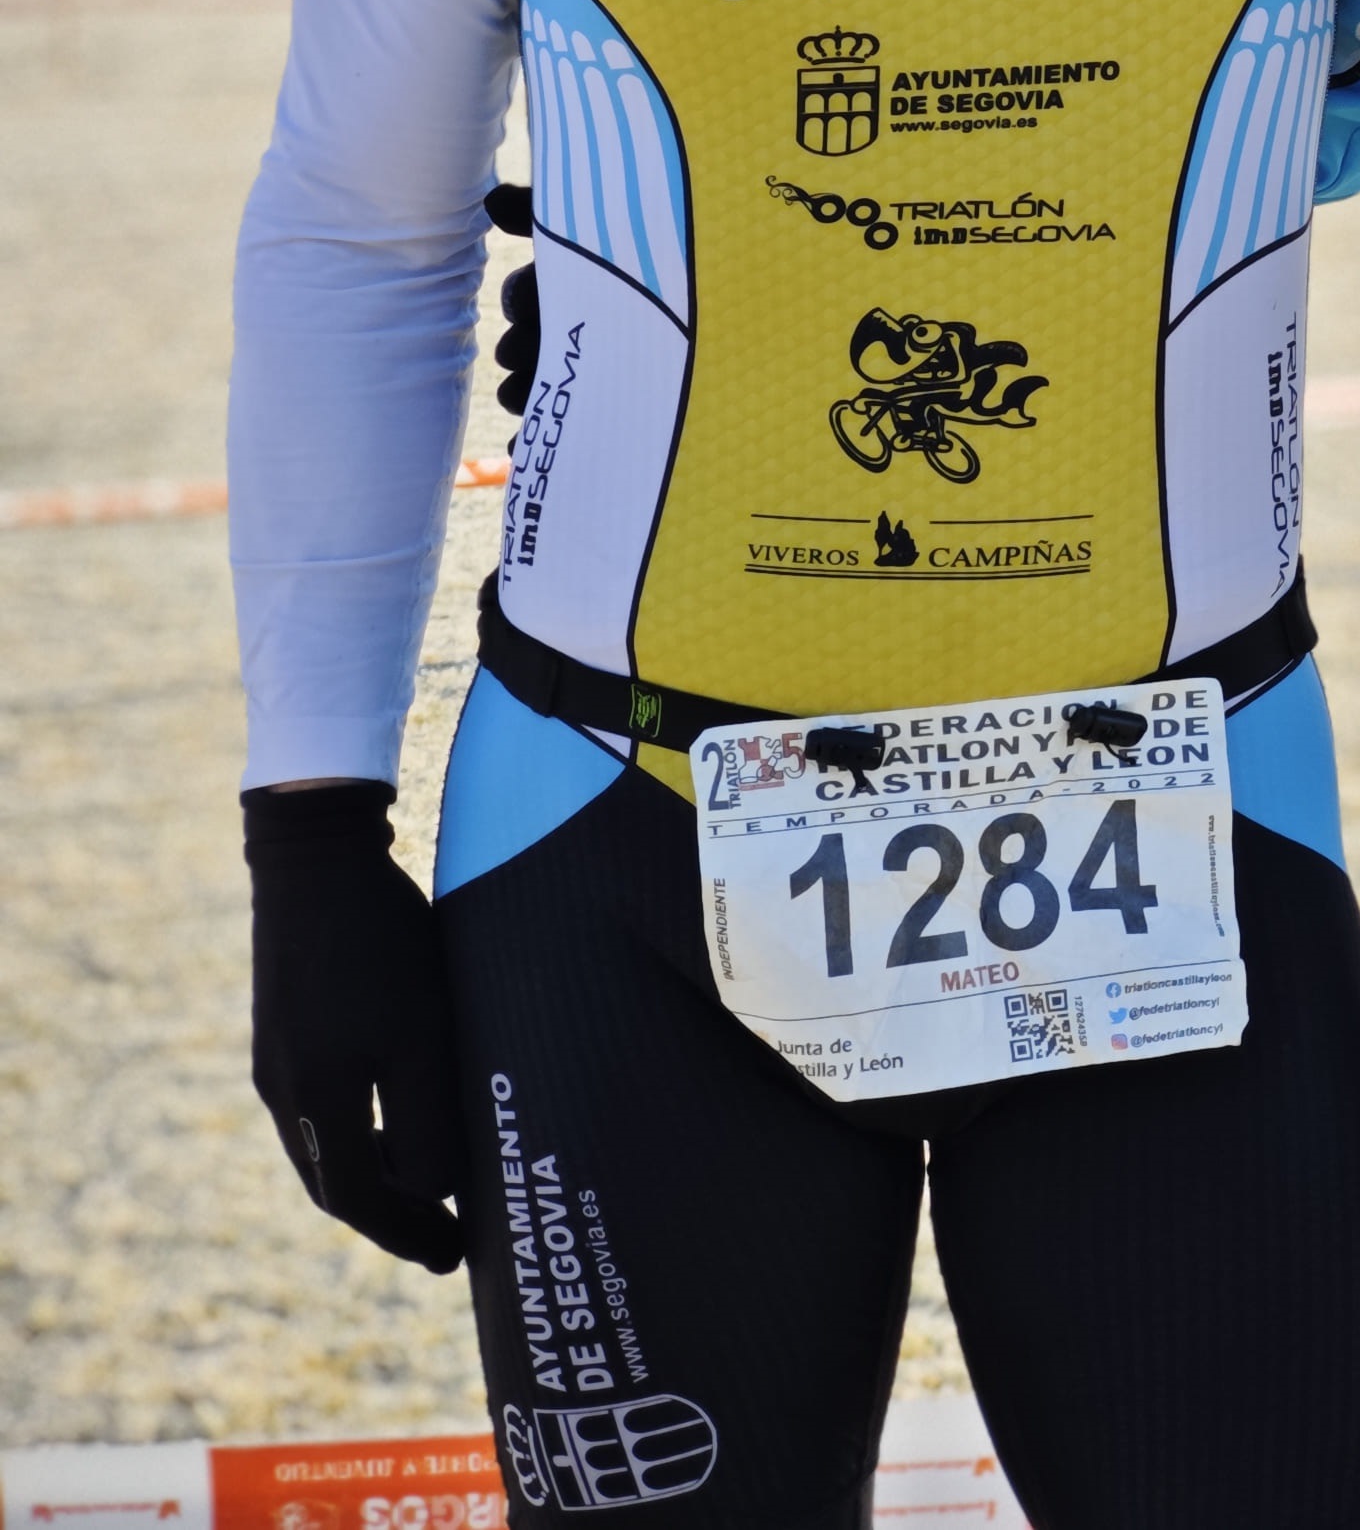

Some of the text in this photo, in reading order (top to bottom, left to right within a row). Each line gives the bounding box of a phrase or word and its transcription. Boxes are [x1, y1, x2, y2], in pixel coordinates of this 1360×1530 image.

[891, 61, 1121, 92] AYUNTAMIENTO
[890, 90, 1065, 116] DE SEGOVIA
[890, 115, 1038, 133] www.segovia.es
[890, 192, 1065, 221] TRIATLÓN
[748, 540, 1092, 568] VIVEROS CAMPIÑAS
[1152, 690, 1208, 712] DE
[1032, 731, 1056, 752] Y
[1153, 717, 1209, 738] DE
[723, 739, 742, 810] TRIATLON
[816, 743, 1209, 801] CASTILLA Y LEON
[789, 799, 1159, 978] 1284
[714, 878, 735, 981] INDEPENDIENTE
[941, 961, 1020, 992] MATEO
[830, 1038, 852, 1054] de
[843, 1062, 853, 1080] y
[860, 1053, 903, 1072] León
[490, 1073, 567, 1393] AYUNTAMIENTO
[531, 1154, 615, 1392] DE SEGOVIA
[578, 1189, 650, 1384] www.segovia.es
[274, 1457, 395, 1482] JUVENTUD
